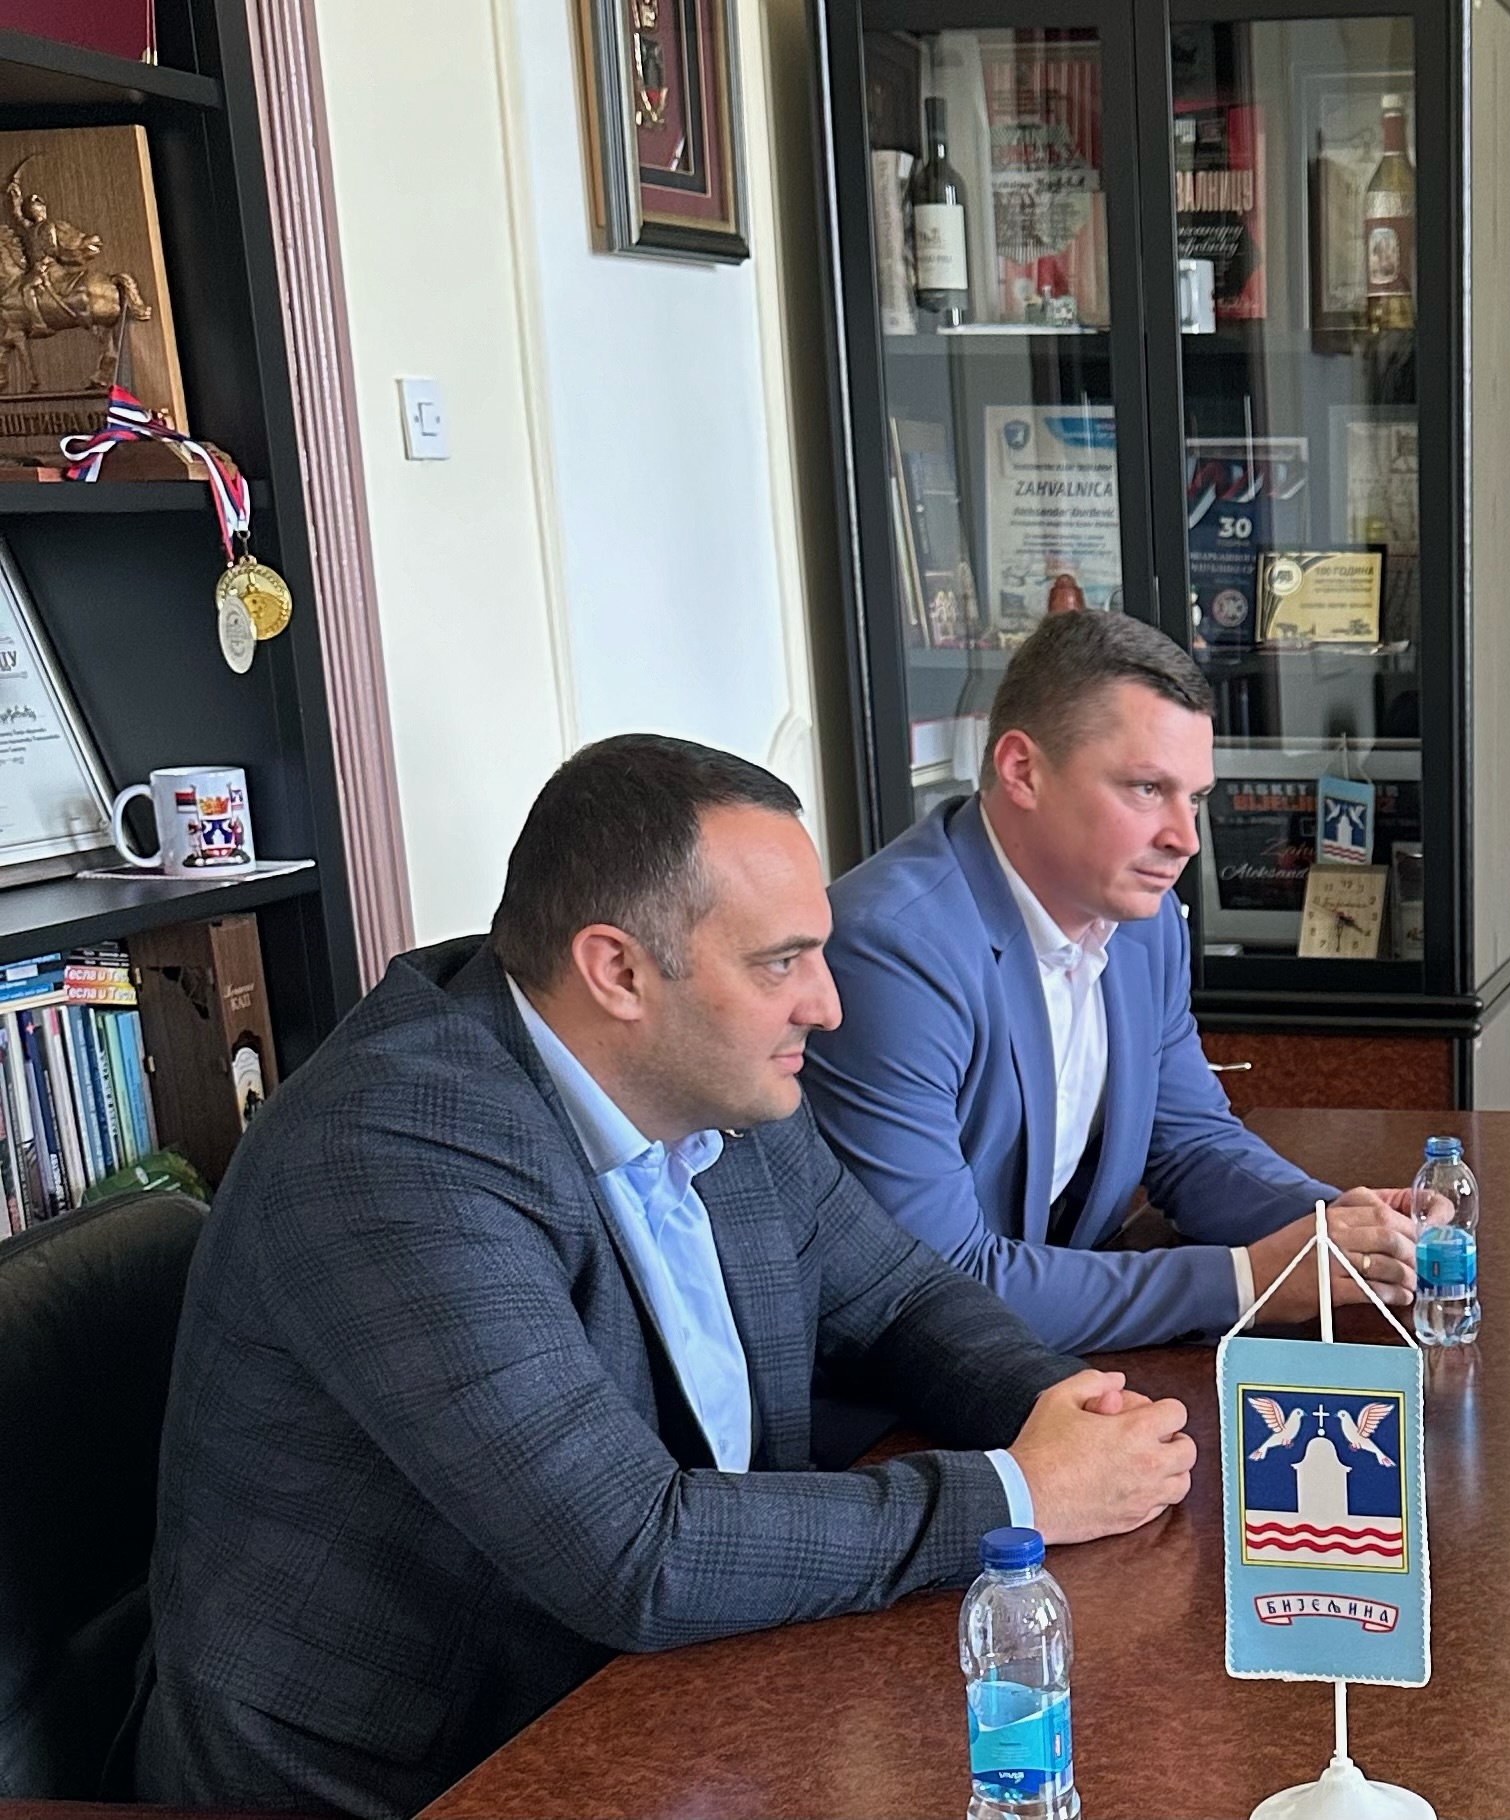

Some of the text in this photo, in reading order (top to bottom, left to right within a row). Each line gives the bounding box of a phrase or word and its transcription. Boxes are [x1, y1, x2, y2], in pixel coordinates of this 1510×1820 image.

[1015, 481, 1113, 497] ZAHVALNICA
[1218, 517, 1252, 538] 30
[1333, 567, 1374, 577] ГОДИНА
